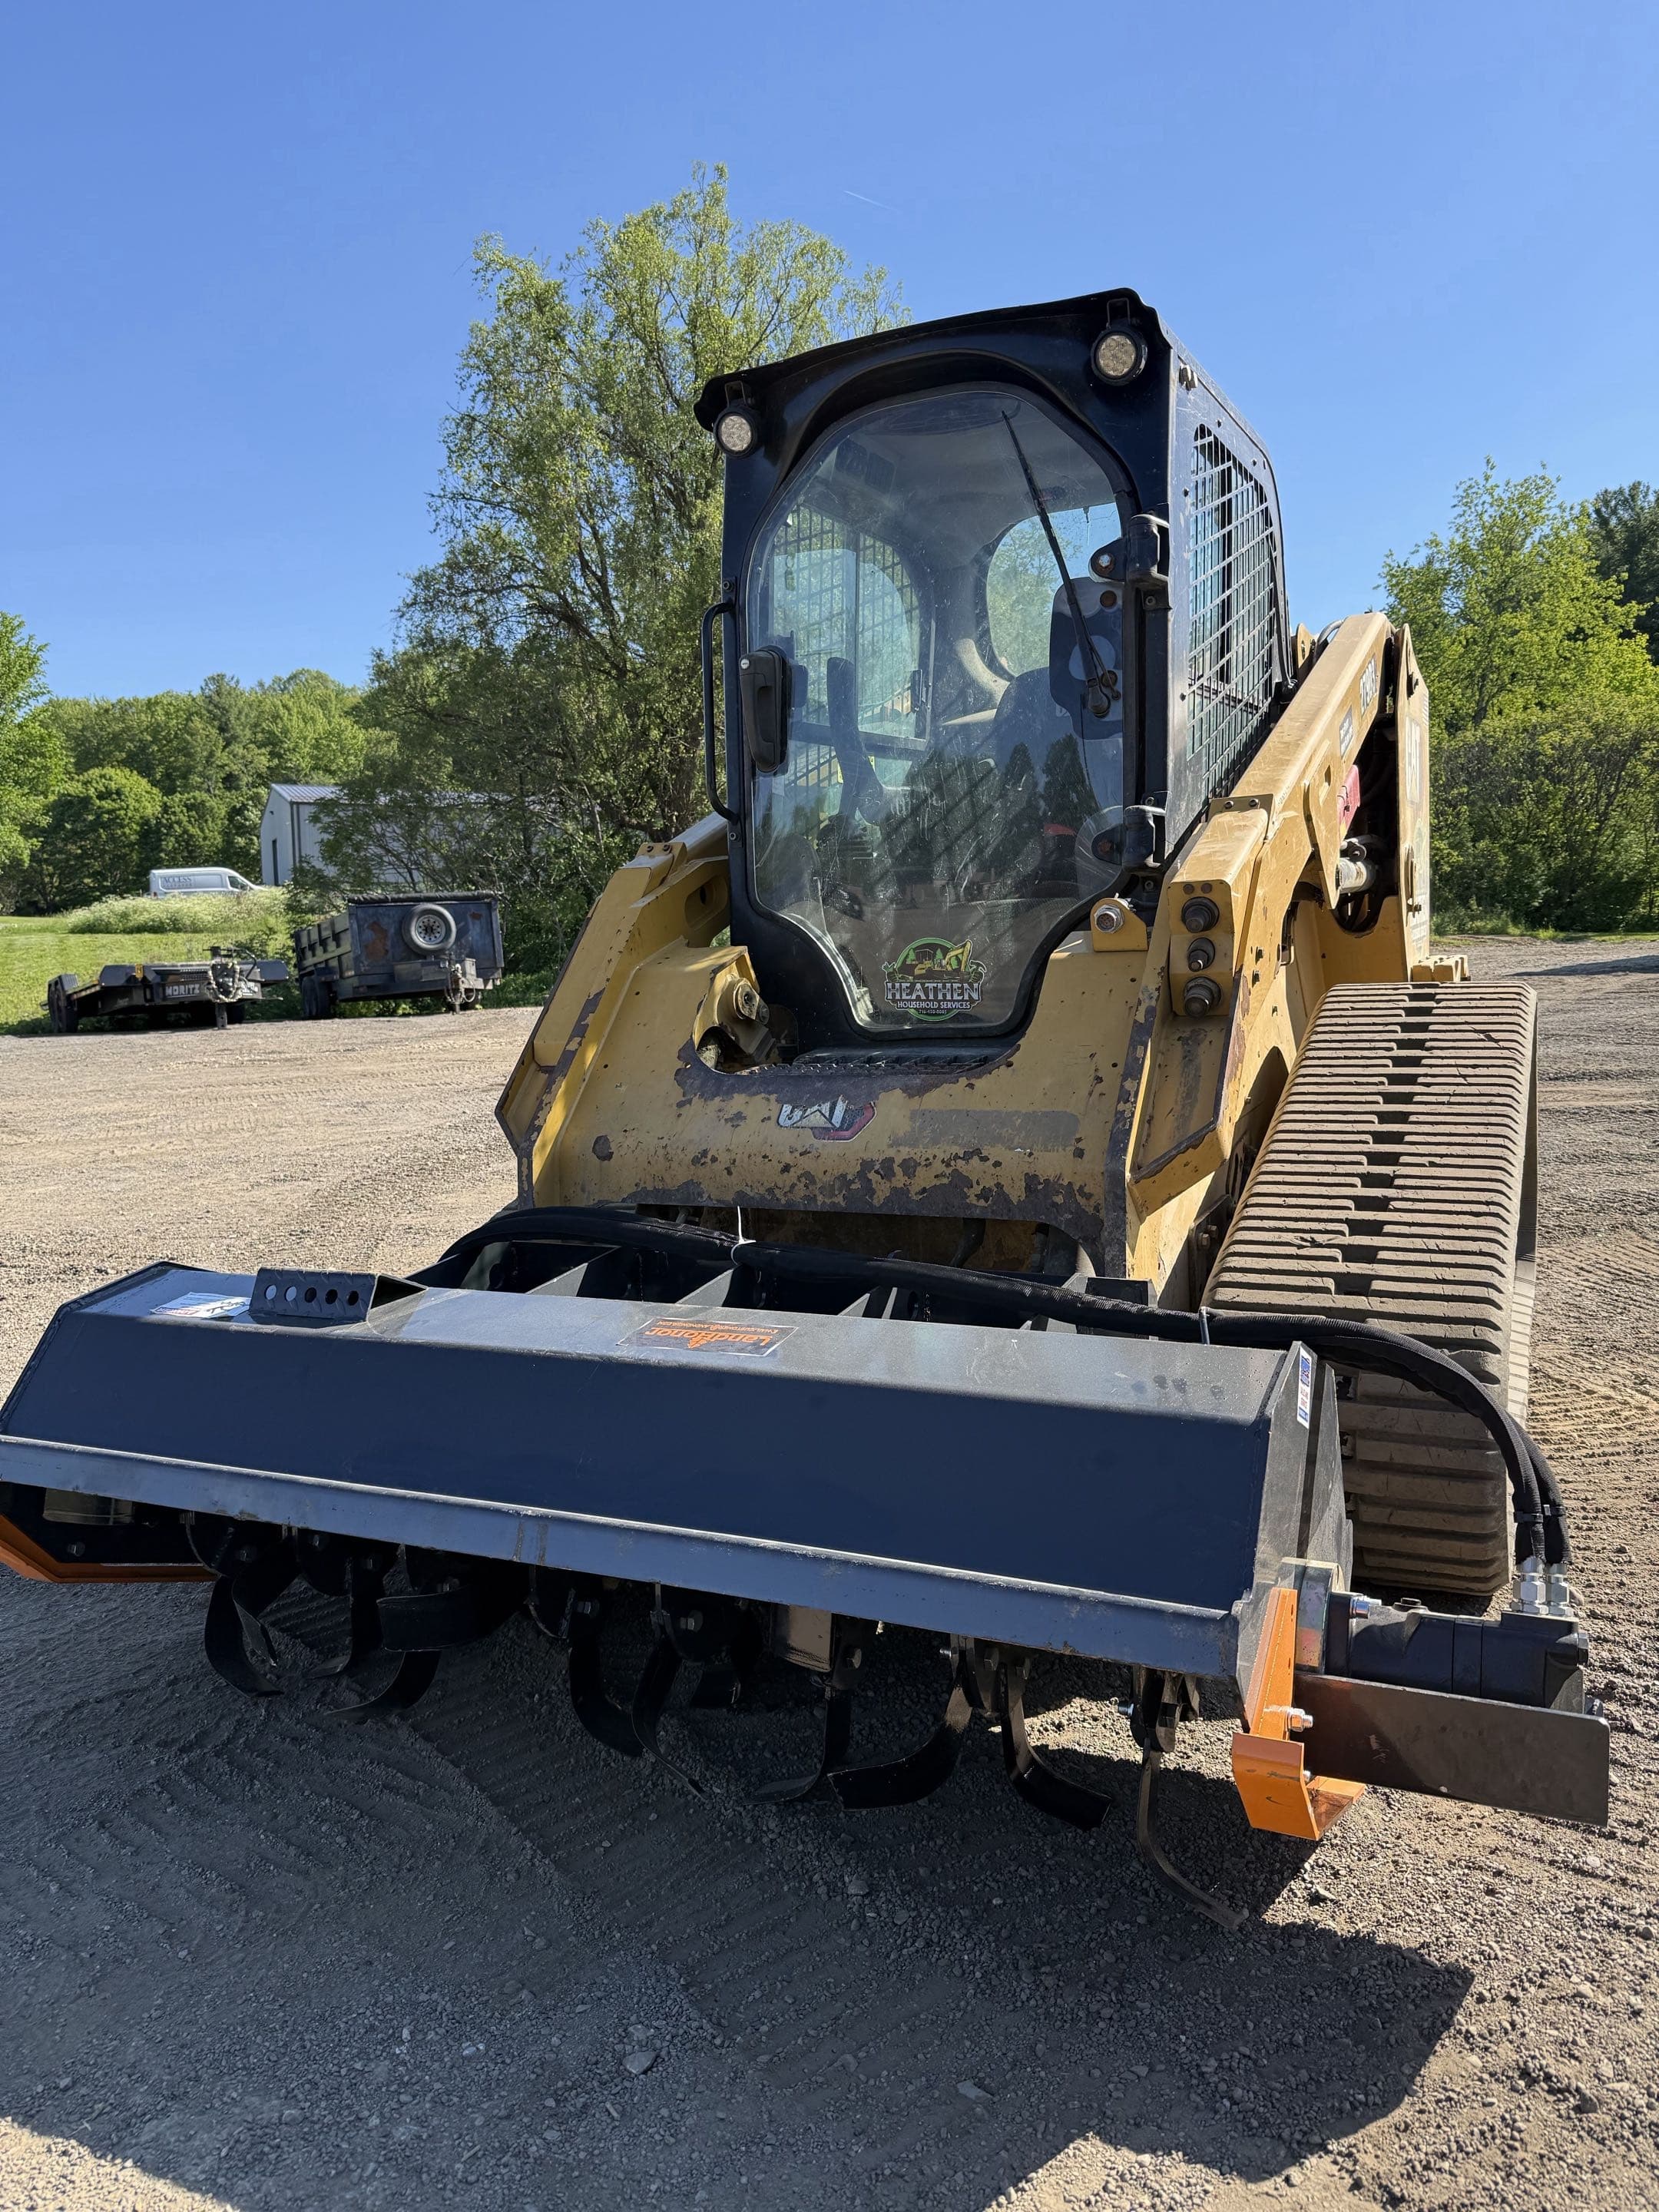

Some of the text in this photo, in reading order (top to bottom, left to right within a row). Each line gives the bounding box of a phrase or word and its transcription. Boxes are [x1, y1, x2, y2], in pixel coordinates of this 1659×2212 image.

[165, 984, 200, 997] MORITZ
[886, 982, 980, 1000] HEATHEN
[897, 1001, 939, 1009] HOUSEHOLD
[644, 1327, 773, 1346] LandHonor
